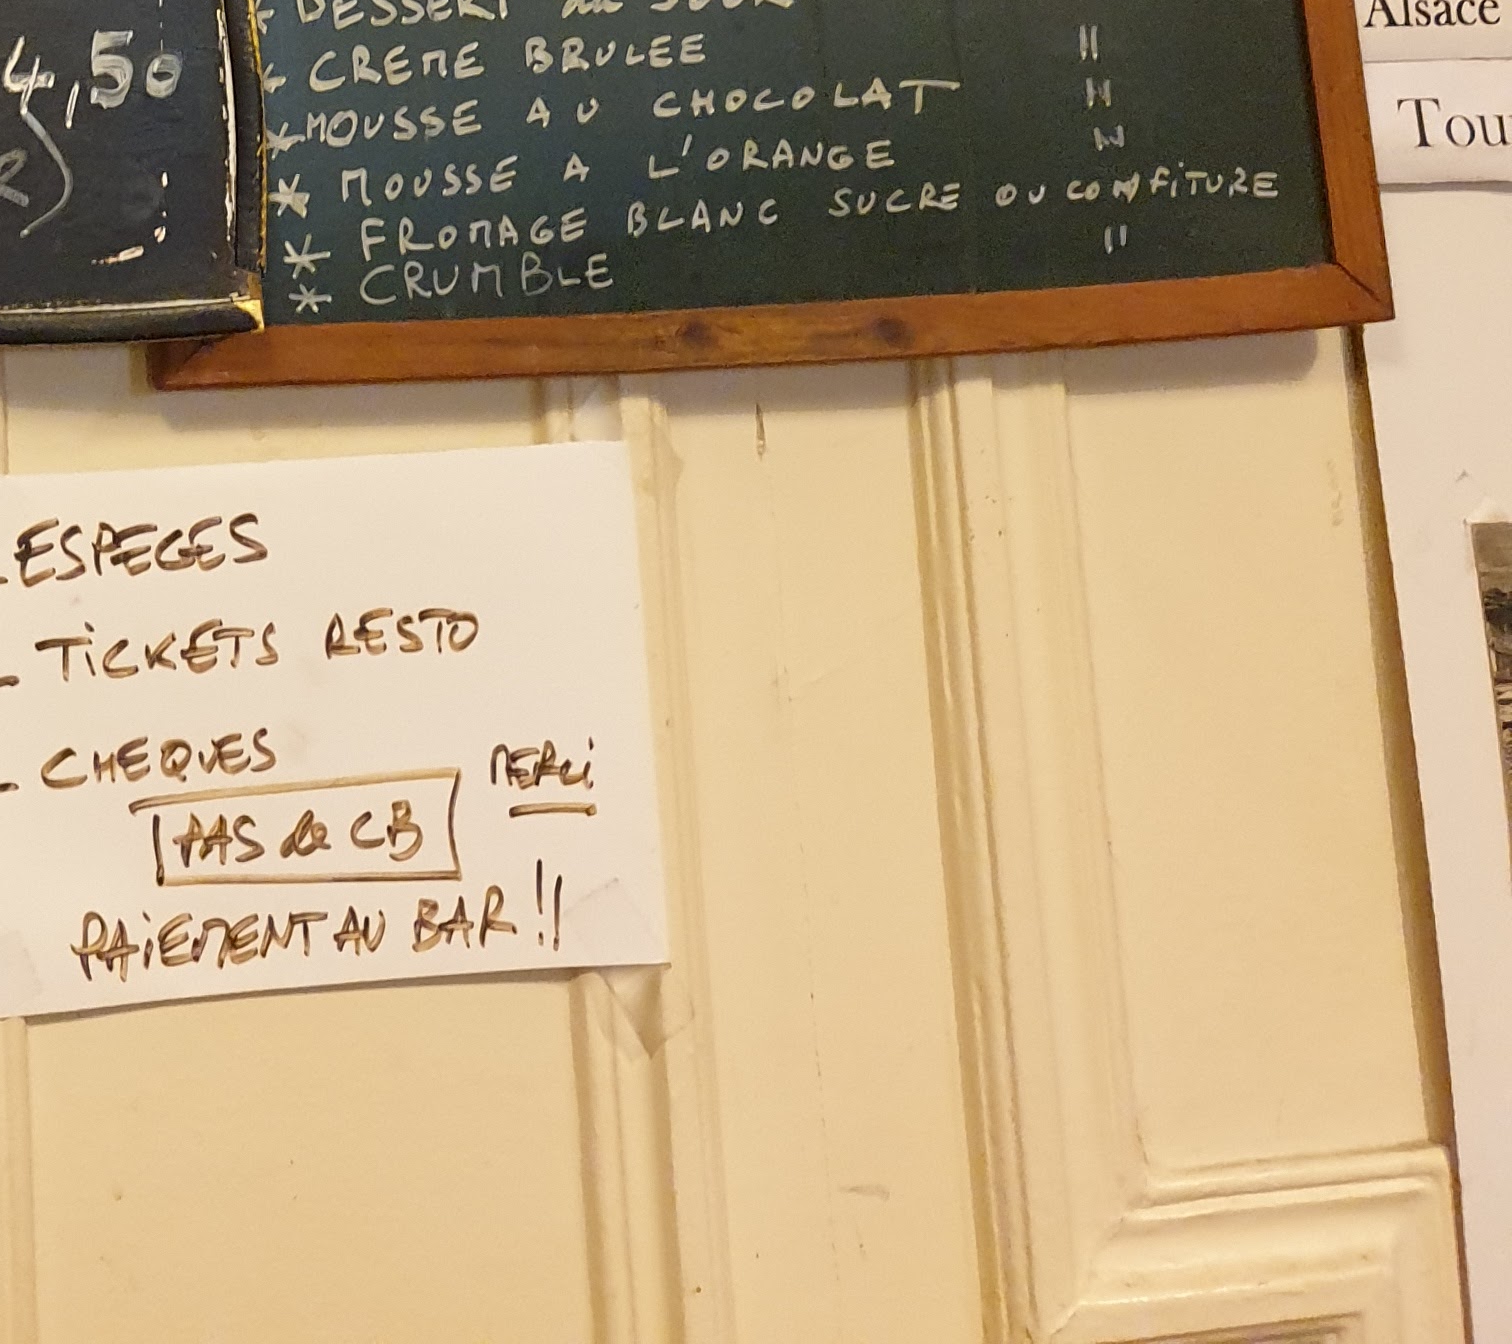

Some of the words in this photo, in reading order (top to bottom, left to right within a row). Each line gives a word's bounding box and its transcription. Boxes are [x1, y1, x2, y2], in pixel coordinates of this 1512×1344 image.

[1, 29, 182, 126] 4,50
[310, 40, 485, 92] CREME
[525, 31, 708, 69] BRULEE
[306, 98, 483, 147] MOUSSE
[652, 78, 961, 119] CHOCOLAT
[341, 155, 518, 205] MOUSSE
[361, 205, 586, 258] FROMAGE
[626, 196, 779, 238] BLANC
[829, 179, 963, 217] SUCRE
[360, 251, 614, 306] CRUMBLE
[327, 607, 479, 658] RESTO
[40, 727, 277, 790] CHEQUES
[173, 814, 266, 867] PAS
[352, 801, 423, 862] CB
[336, 906, 387, 954] AU
